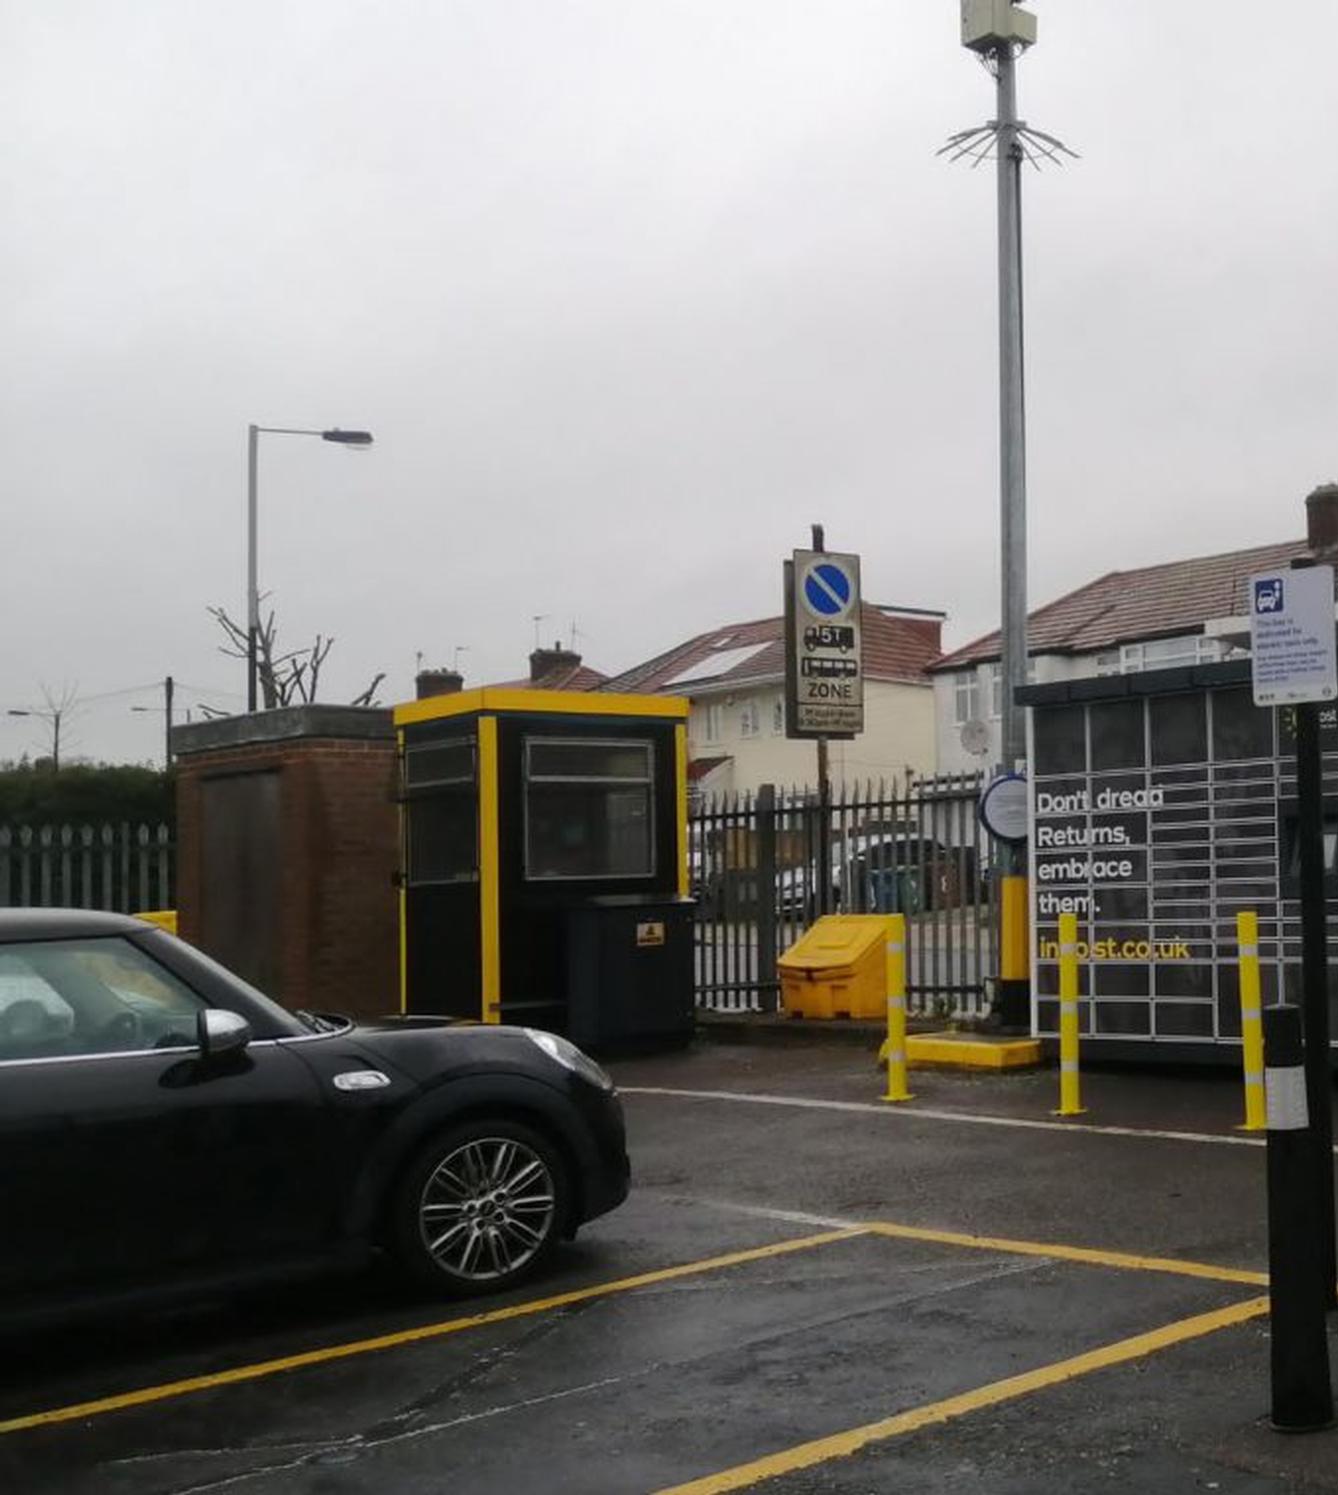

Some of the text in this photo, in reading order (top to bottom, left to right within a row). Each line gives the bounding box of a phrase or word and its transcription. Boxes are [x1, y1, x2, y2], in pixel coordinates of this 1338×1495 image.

[808, 683, 852, 698] ZONE
[1038, 786, 1164, 813] Don't dread
[1038, 826, 1130, 847] Returns,
[1039, 858, 1132, 880] embrace
[1039, 892, 1101, 913] them.
[1040, 935, 1190, 959] inost.co.uk
